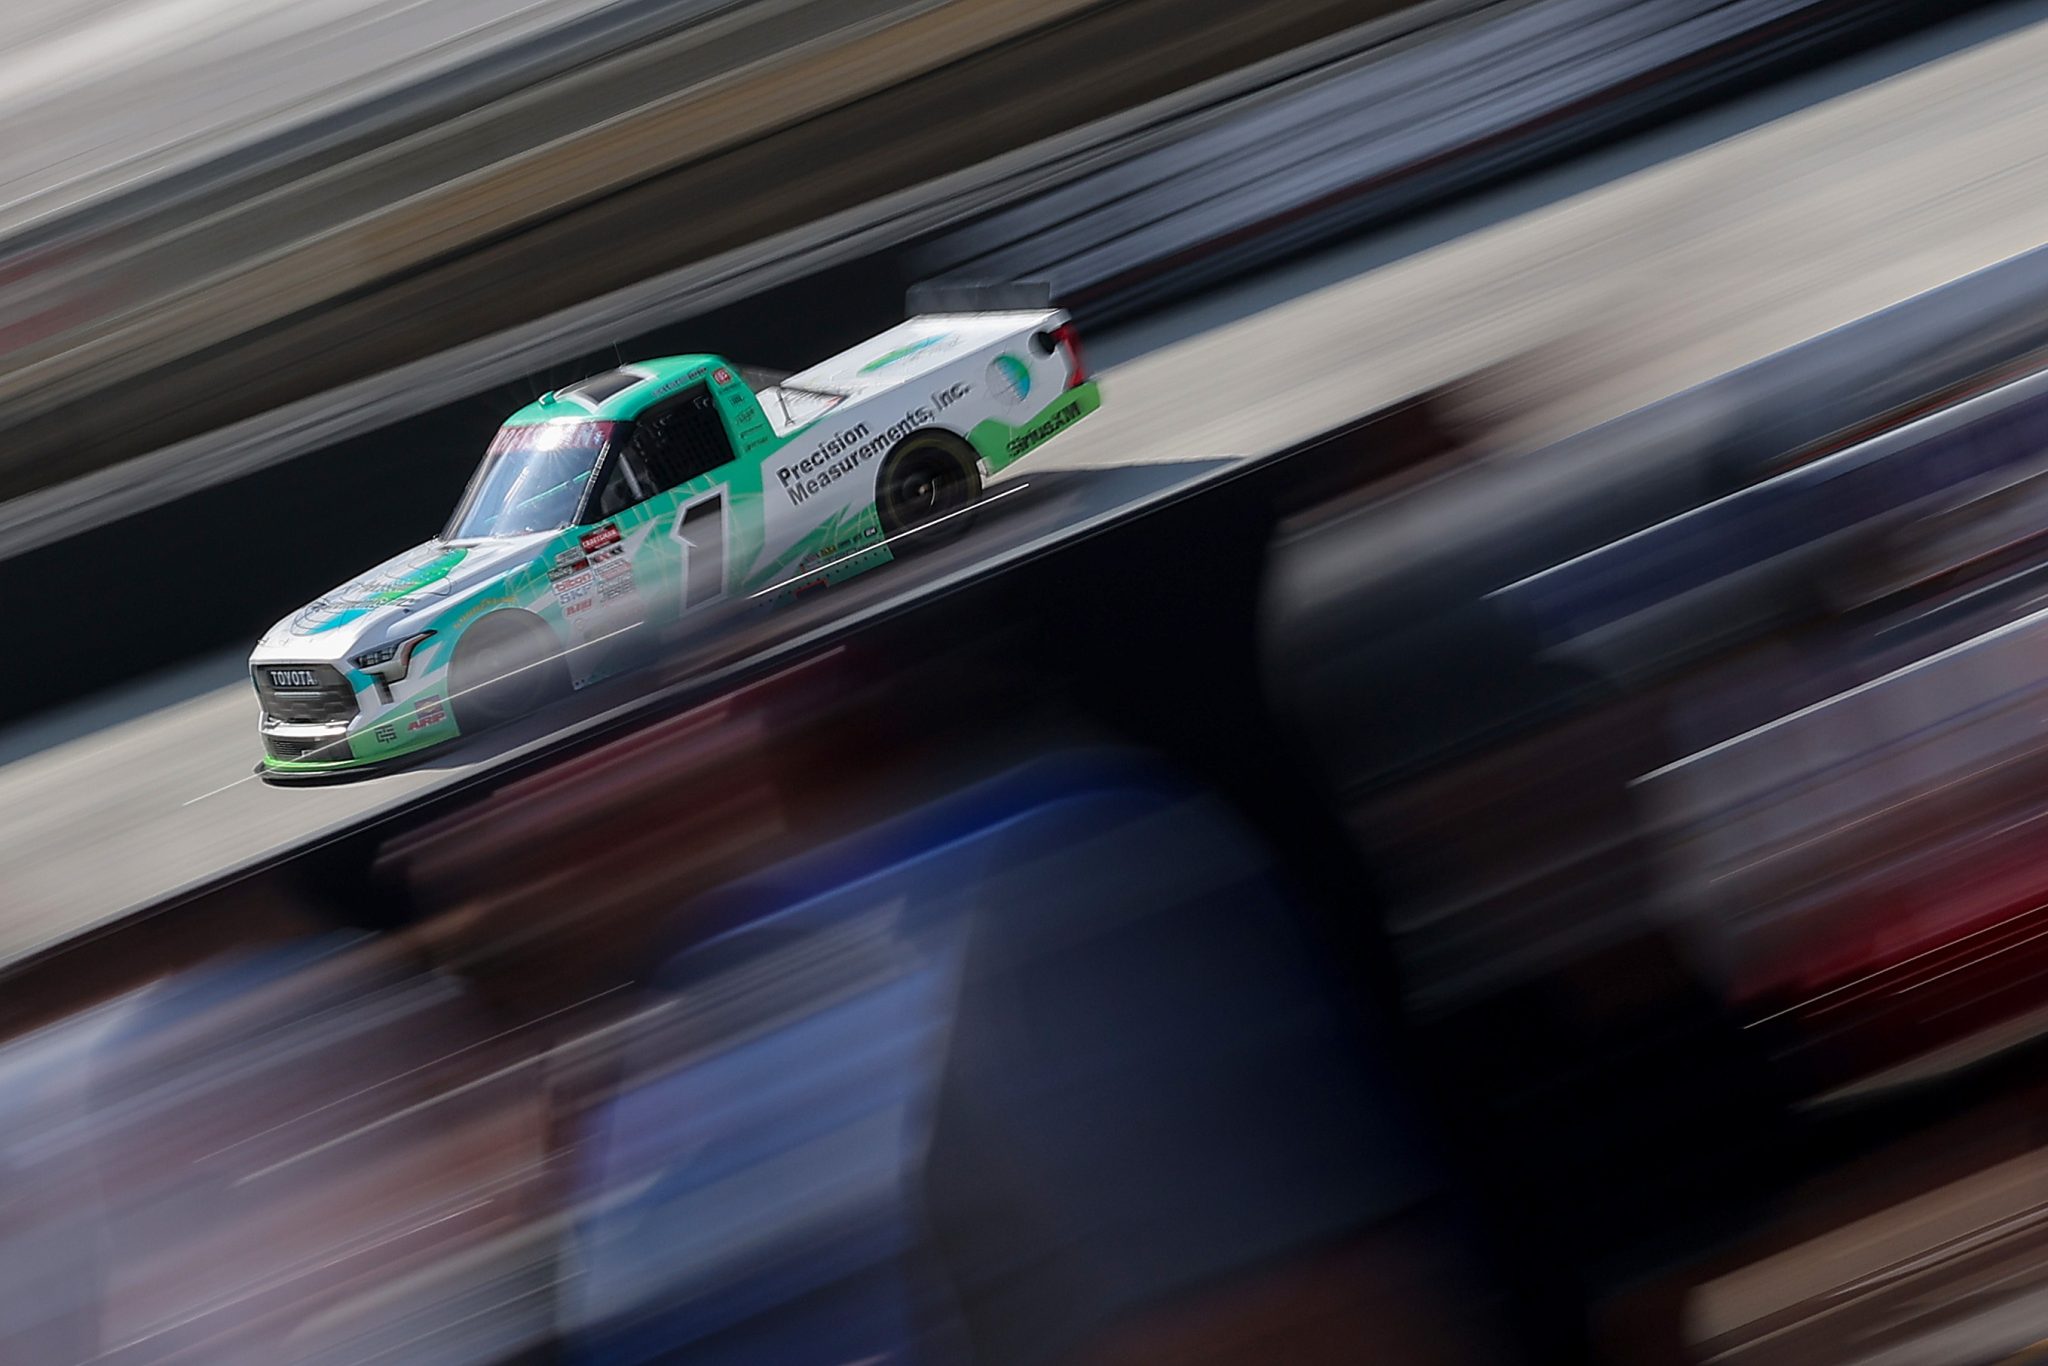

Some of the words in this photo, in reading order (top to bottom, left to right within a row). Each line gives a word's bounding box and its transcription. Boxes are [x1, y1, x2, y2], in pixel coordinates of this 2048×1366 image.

[776, 421, 870, 488] Precision
[787, 406, 937, 506] Measurements,
[931, 381, 970, 411] Inc.
[669, 481, 728, 616] 1
[560, 586, 592, 605] SKF
[270, 671, 316, 687] TOYOTA
